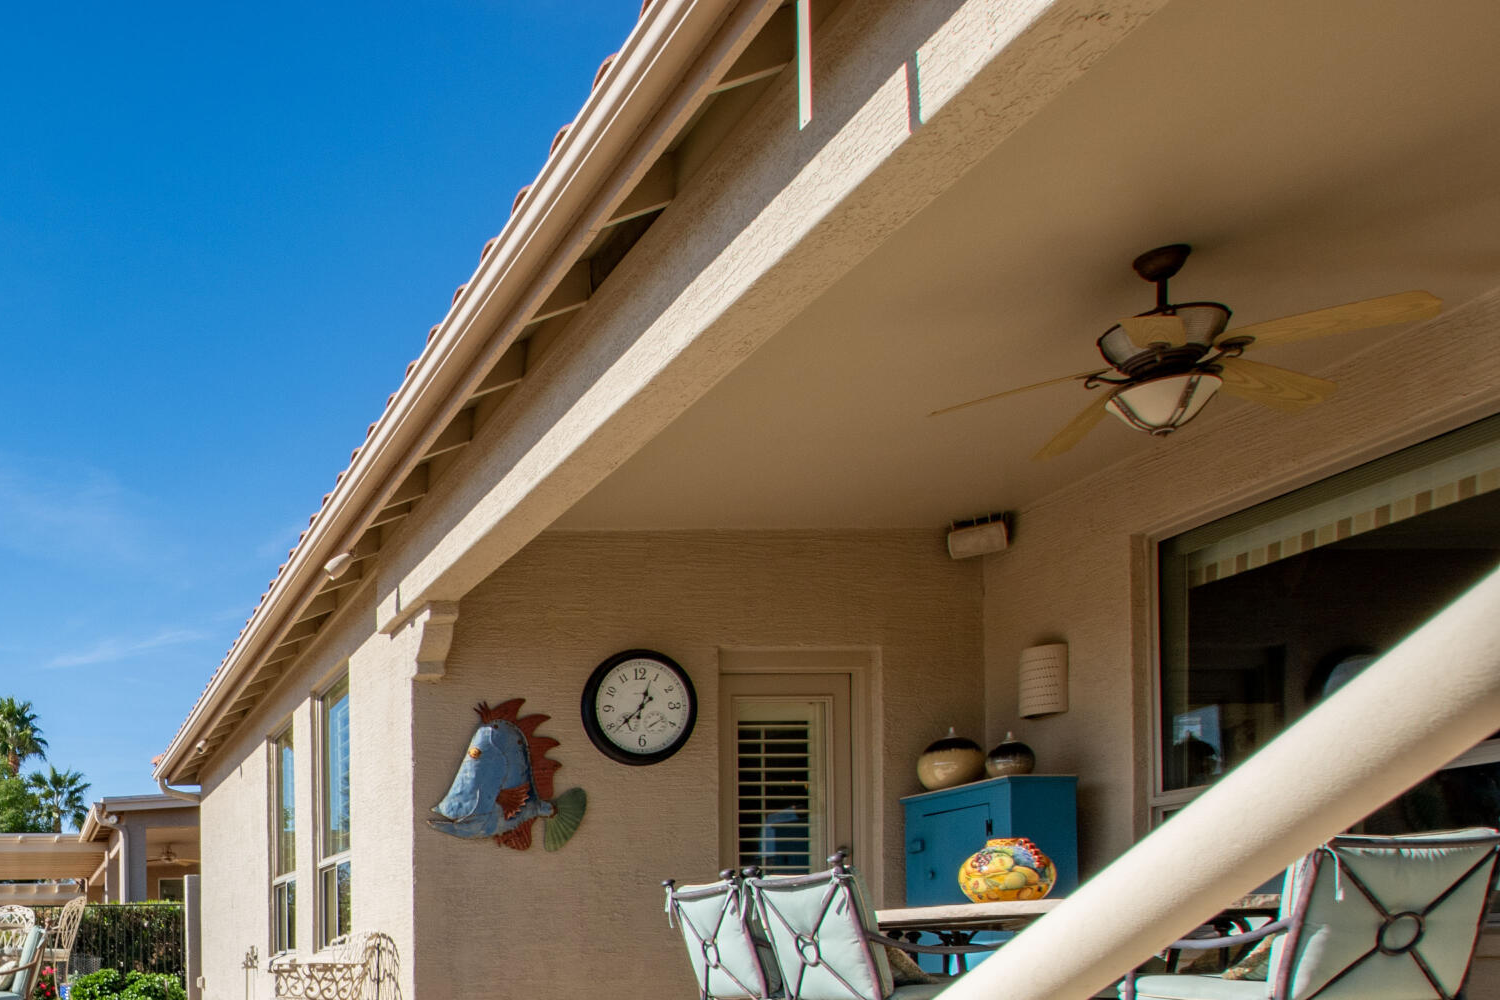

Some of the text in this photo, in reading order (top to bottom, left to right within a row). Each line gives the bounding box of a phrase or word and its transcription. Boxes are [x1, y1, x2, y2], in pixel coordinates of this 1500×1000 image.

[619, 672, 628, 683] 11
[634, 667, 646, 680] 12
[653, 673, 659, 682] 1
[606, 686, 617, 698] 10
[664, 685, 674, 694] 2
[603, 705, 615, 713] 9
[668, 702, 681, 710] 3
[606, 722, 616, 730] 8
[638, 734, 647, 747] 6
